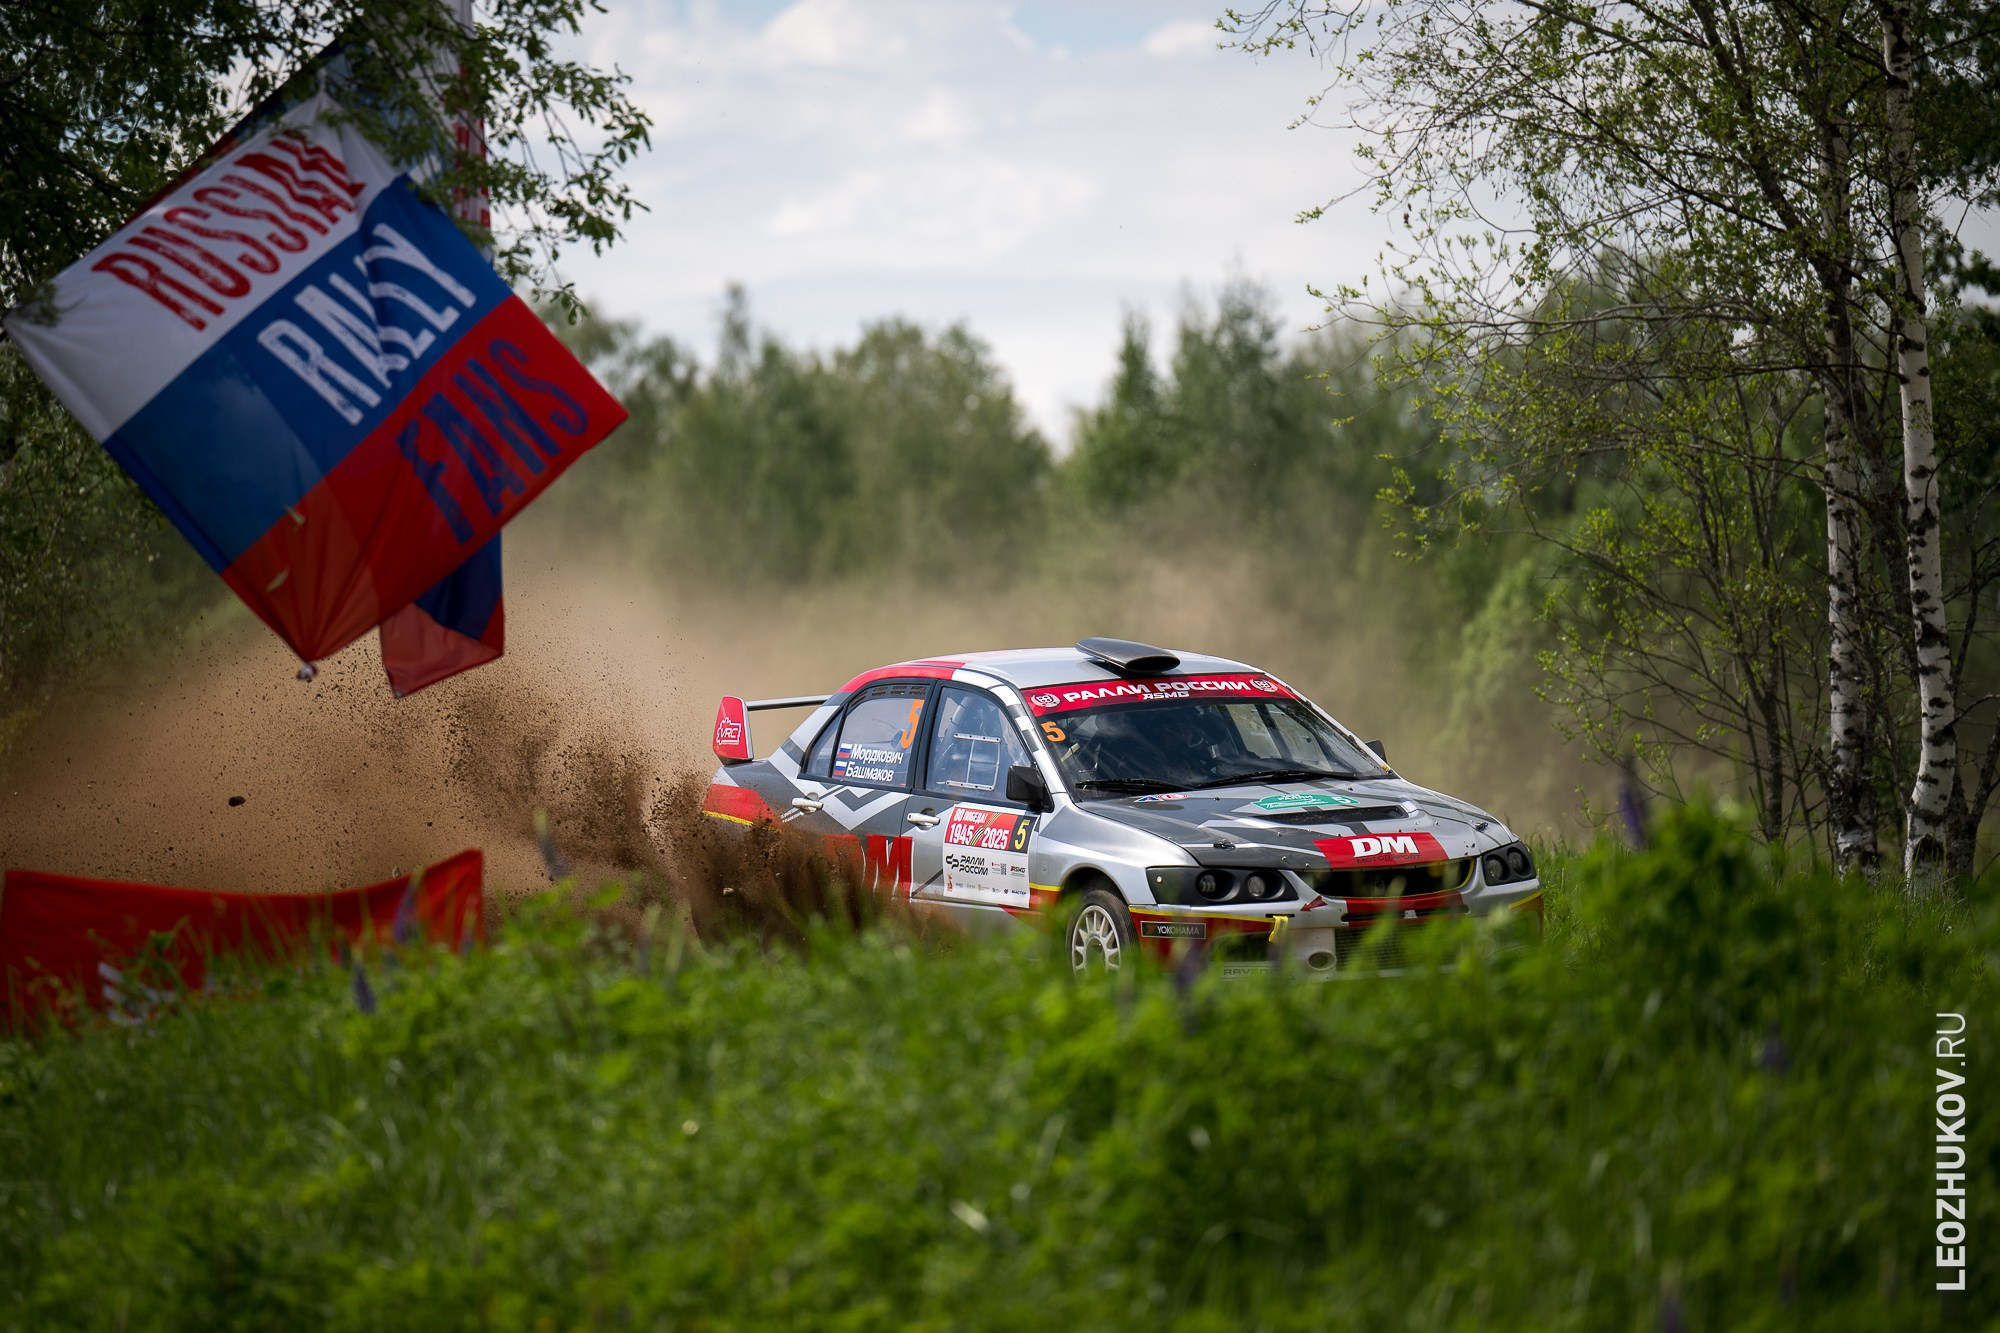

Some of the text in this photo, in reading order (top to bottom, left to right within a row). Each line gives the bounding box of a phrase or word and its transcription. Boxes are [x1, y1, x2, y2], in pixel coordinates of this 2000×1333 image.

[91, 129, 366, 331] RUSSIAN
[257, 223, 476, 425] RALLY
[397, 337, 588, 545] FANS
[1063, 683, 1150, 703] РАЛЛИ
[1154, 679, 1251, 693] РОССИИ
[901, 699, 925, 748] 5
[1041, 721, 1066, 742] 5
[850, 744, 904, 764] Мордкович
[845, 761, 894, 782] Башмаков
[949, 823, 1010, 850] 1945 2025
[1014, 819, 1031, 850] 5
[1348, 836, 1419, 858] DM
[959, 864, 989, 876] РОССИИ
[960, 855, 985, 866] РАЛЛИ
[1356, 854, 1421, 864] MOTORSPORT
[1157, 925, 1200, 936] YOKOHAMA
